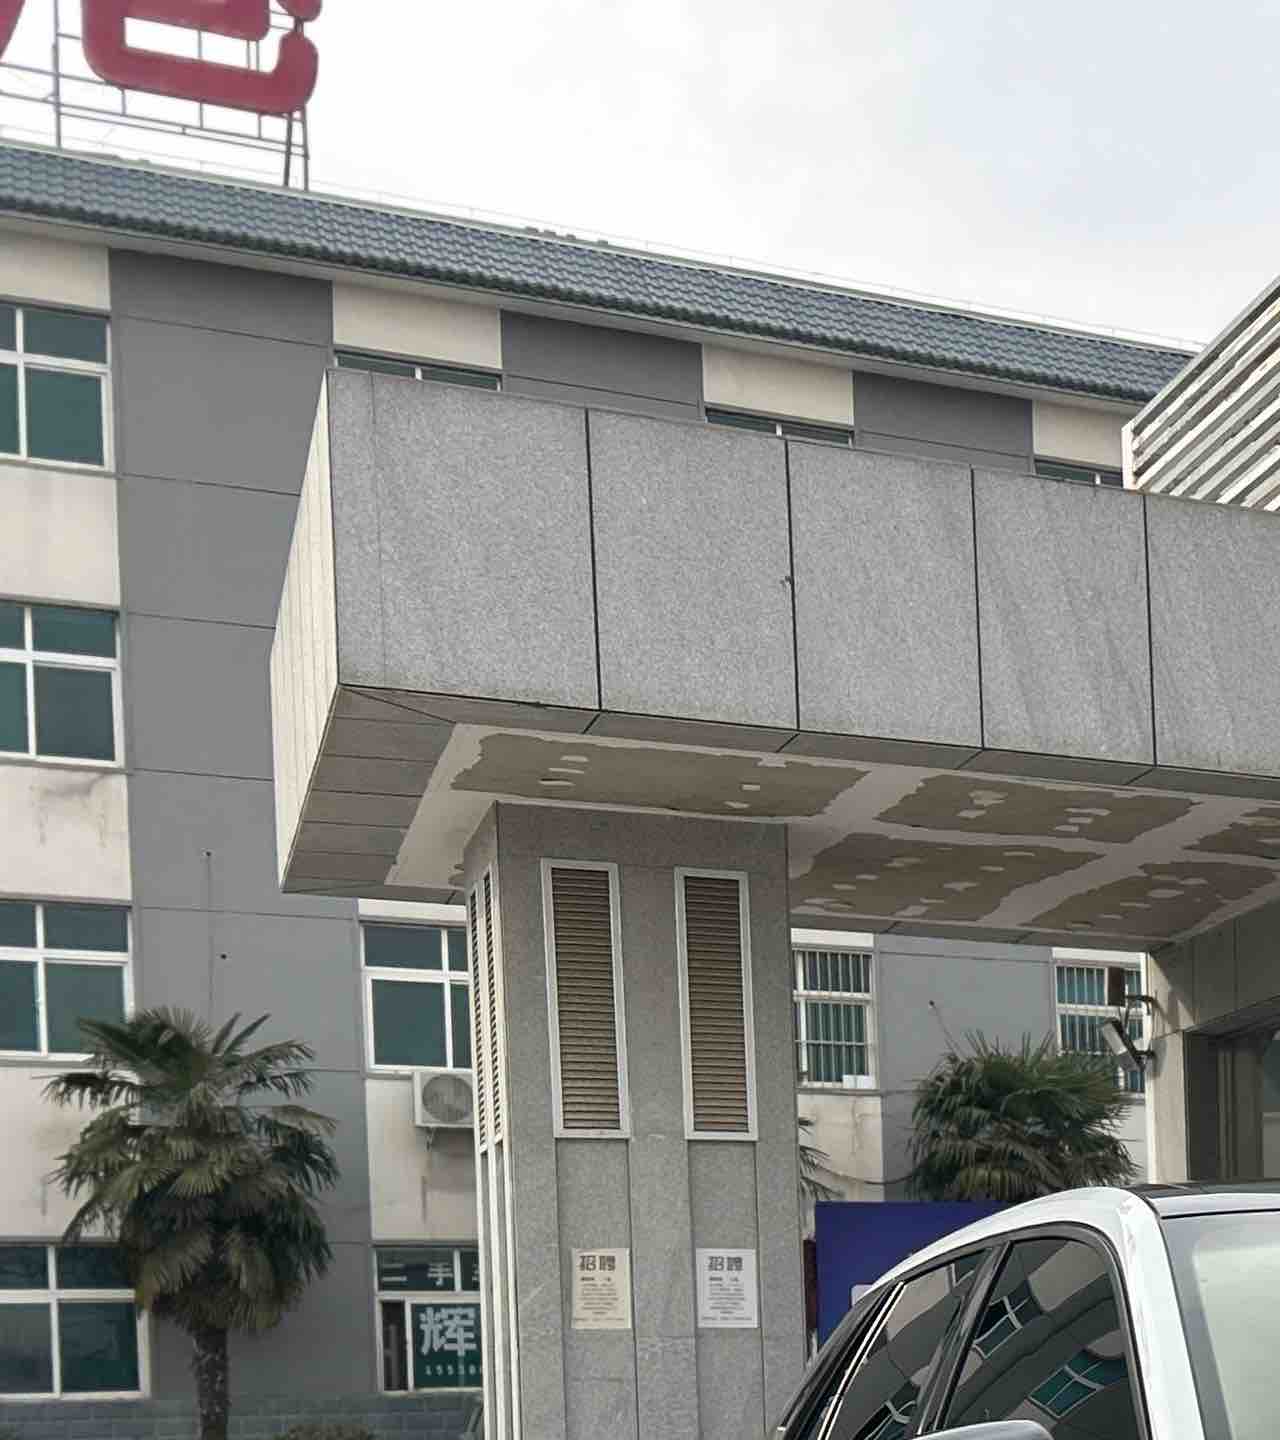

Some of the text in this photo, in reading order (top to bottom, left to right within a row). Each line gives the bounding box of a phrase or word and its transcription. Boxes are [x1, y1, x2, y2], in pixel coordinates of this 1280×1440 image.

[579, 1255, 616, 1271] 招聘
[708, 1256, 743, 1271] 招聘
[419, 1307, 477, 1357] 辉
